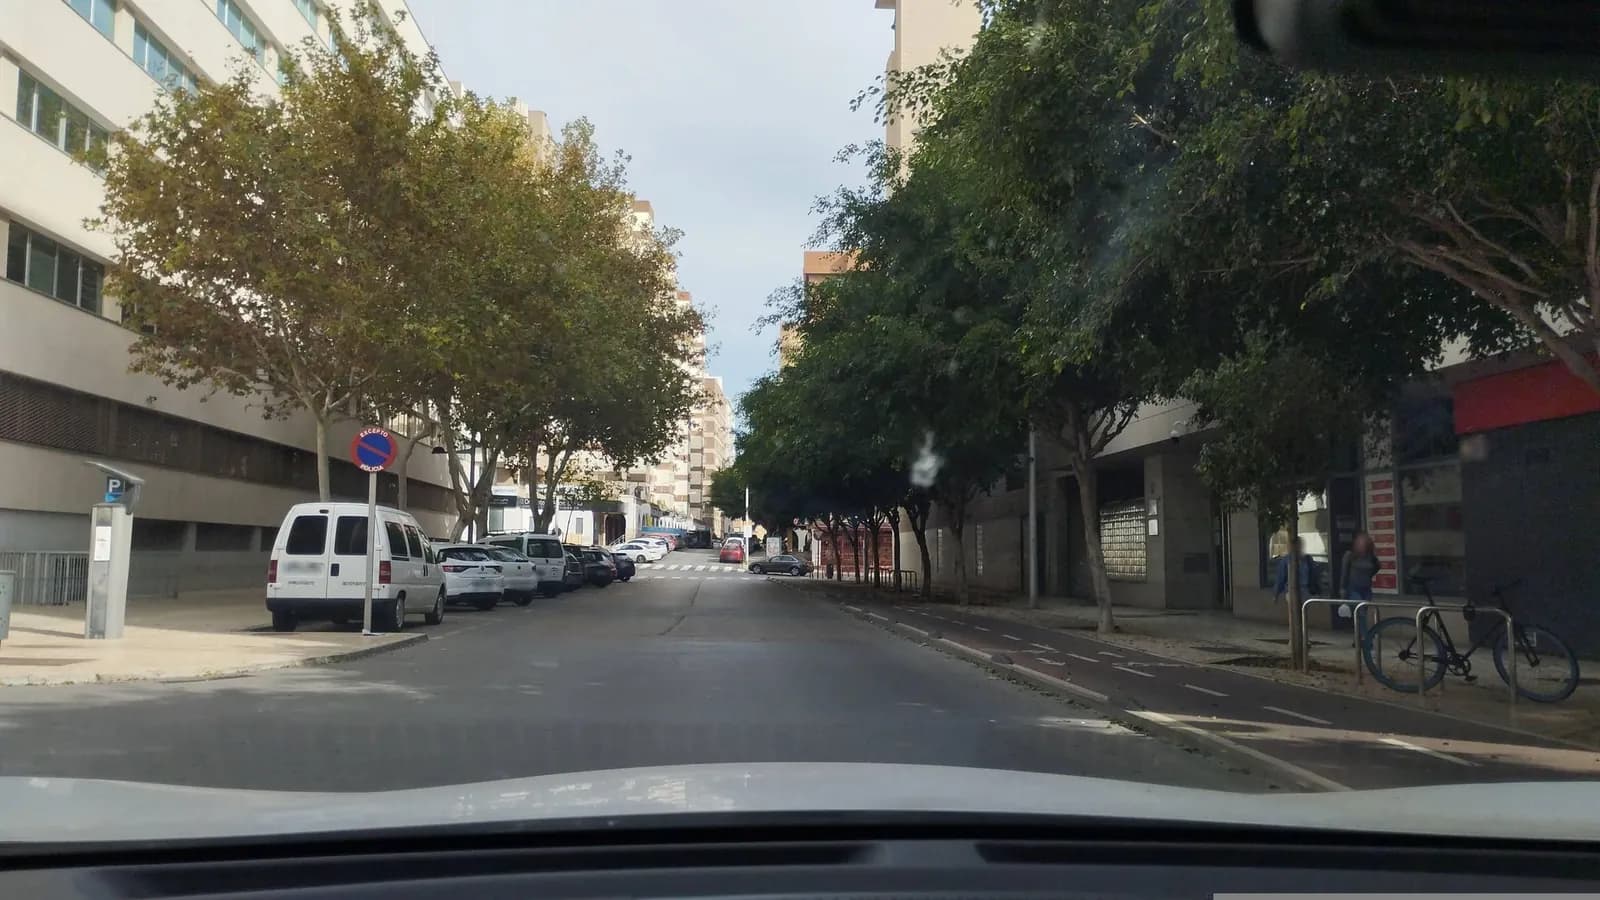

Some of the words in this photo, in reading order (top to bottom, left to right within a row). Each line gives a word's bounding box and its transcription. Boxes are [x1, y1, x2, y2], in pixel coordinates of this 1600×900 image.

[360, 428, 389, 438] EXCEPTO
[360, 463, 384, 472] POLICIA
[108, 479, 121, 493] P
